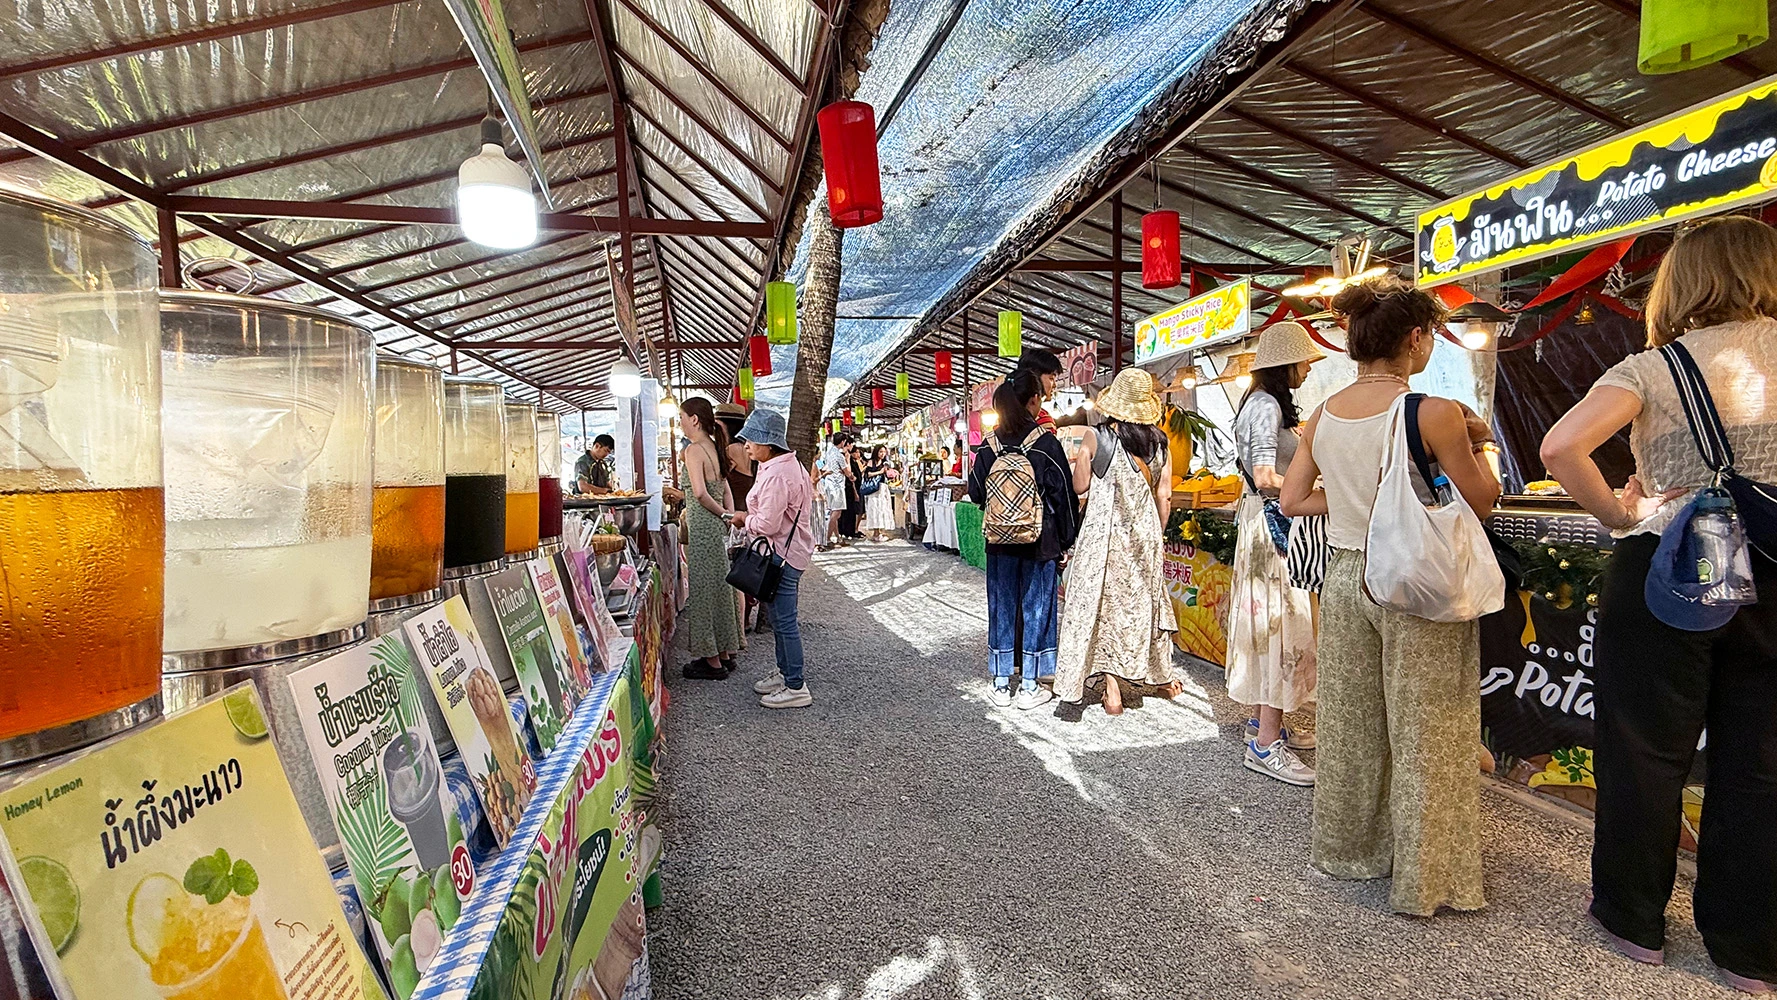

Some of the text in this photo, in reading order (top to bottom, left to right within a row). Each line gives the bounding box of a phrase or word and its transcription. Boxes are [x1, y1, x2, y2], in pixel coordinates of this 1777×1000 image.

[1596, 137, 1776, 207] Potato Cheese
[1159, 298, 1222, 328] Mango Sticky Rice
[417, 620, 460, 668] น้ำลำไย
[314, 664, 401, 748] น้ำมะพร้าว
[333, 725, 393, 778] Coconut juice
[522, 759, 534, 786] 30
[1267, 756, 1285, 772] N
[4, 776, 84, 822] Honey Lemon
[100, 758, 243, 869] น้ำผึ้งมะนาว
[452, 851, 472, 890] 30
